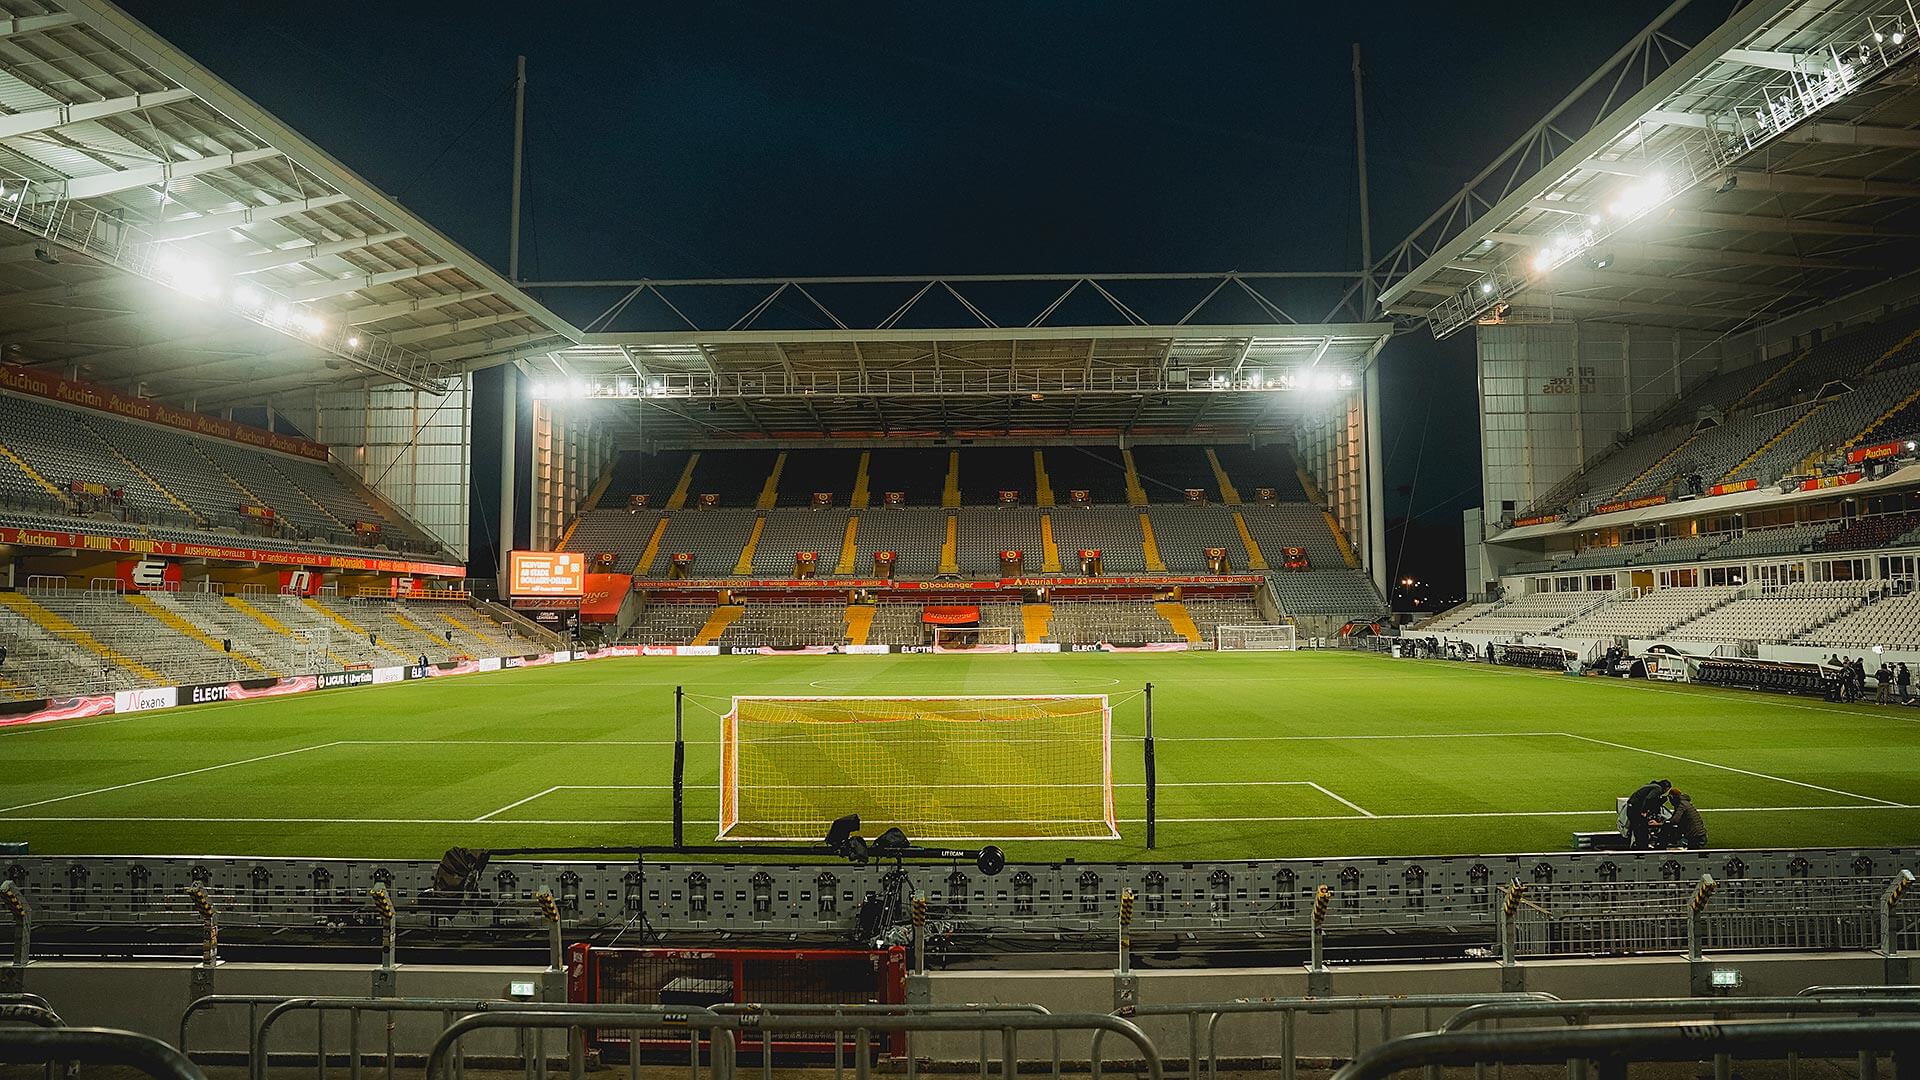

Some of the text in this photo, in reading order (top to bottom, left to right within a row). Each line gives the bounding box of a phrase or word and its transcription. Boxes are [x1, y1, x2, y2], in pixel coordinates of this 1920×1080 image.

[56, 381, 102, 408] Auchan
[108, 394, 150, 418] Auchan
[156, 406, 192, 429] Auchan
[197, 416, 231, 437] Auchan
[235, 426, 266, 446] Auchan
[270, 434, 298, 453] Auchan
[1865, 446, 1892, 460] Auchan
[1722, 481, 1748, 495] WINAMAX
[17, 529, 57, 547] Auchan
[84, 535, 154, 553] PUMA PUMA
[930, 582, 974, 590] boulanger
[1024, 578, 1053, 586] Azurial
[326, 676, 345, 686] LIGUE
[126, 691, 166, 711] Nexans
